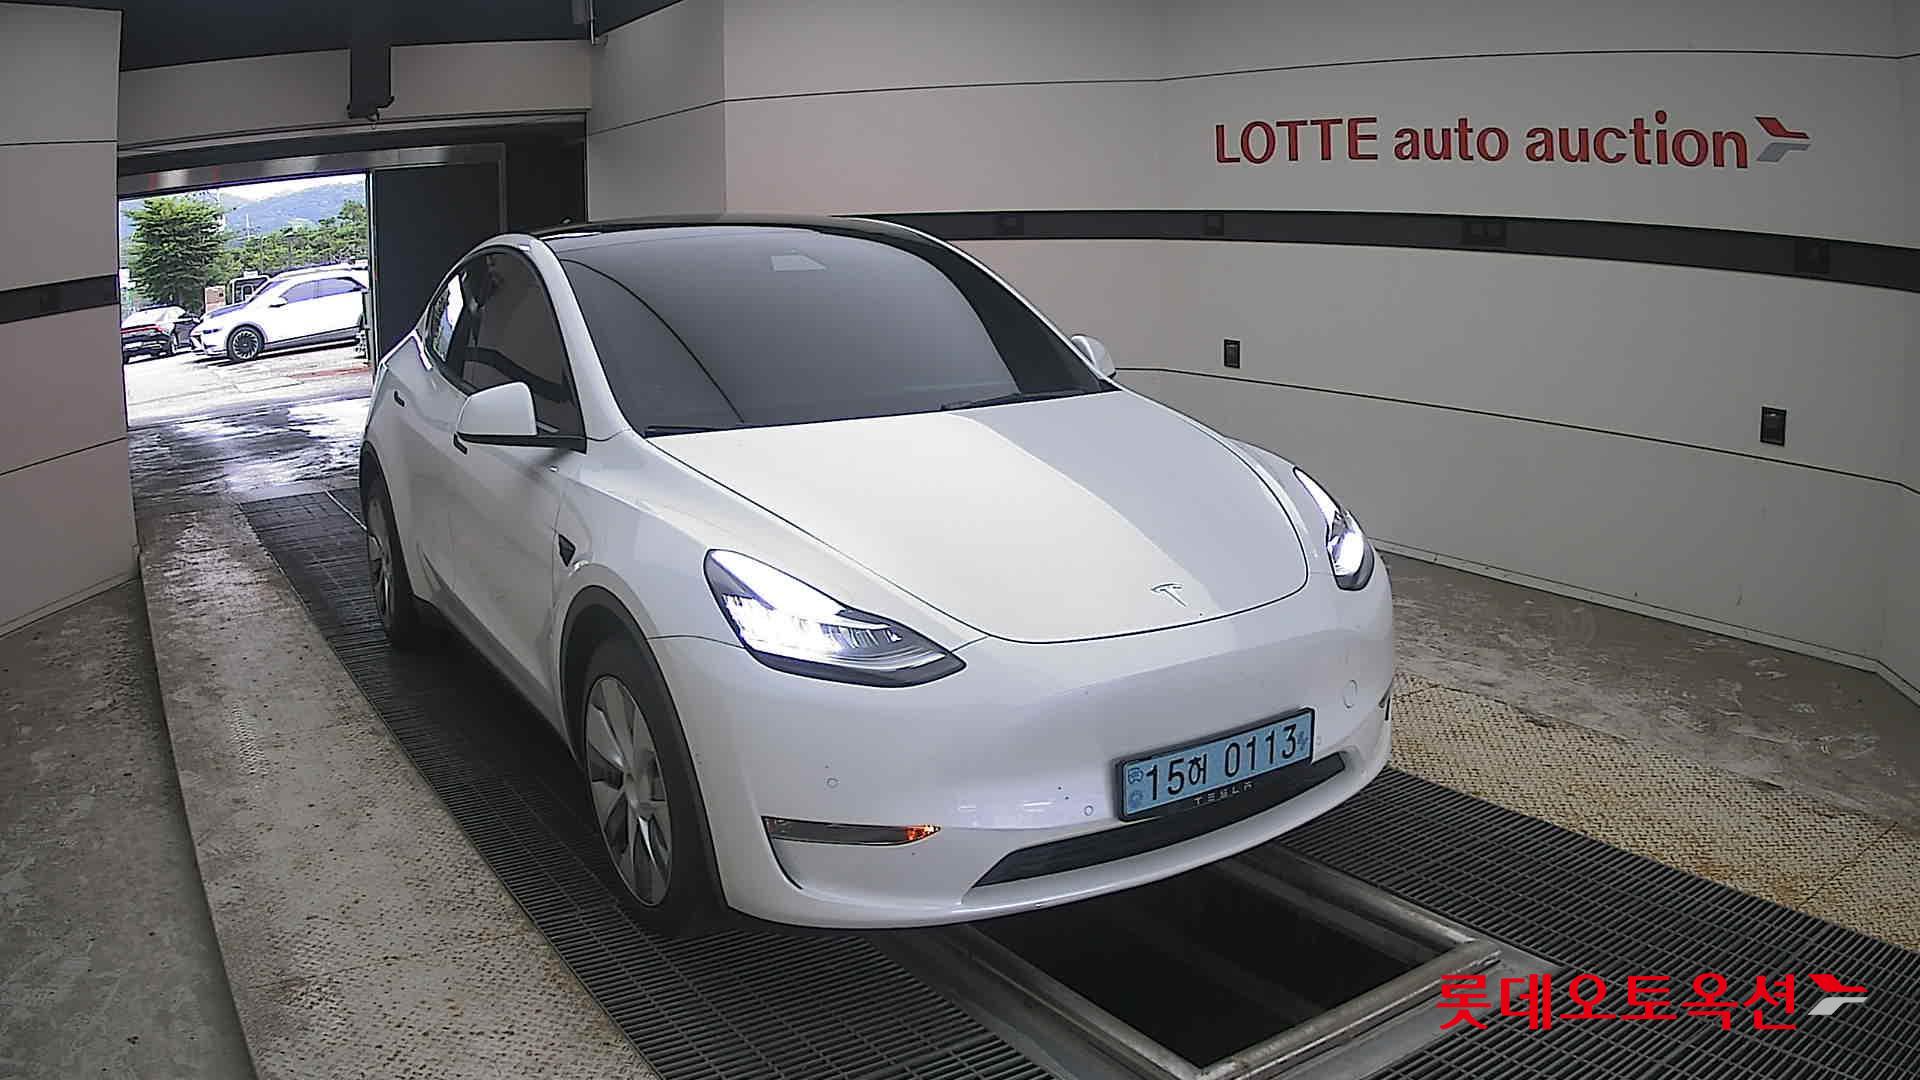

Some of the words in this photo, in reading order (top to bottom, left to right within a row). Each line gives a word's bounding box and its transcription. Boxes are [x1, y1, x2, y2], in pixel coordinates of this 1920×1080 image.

[1214, 115, 1379, 164] LOTTE
[1393, 117, 1510, 162] auto
[1524, 110, 1750, 169] auction
[1146, 752, 1208, 801] 15허
[1224, 724, 1298, 778] 0113
